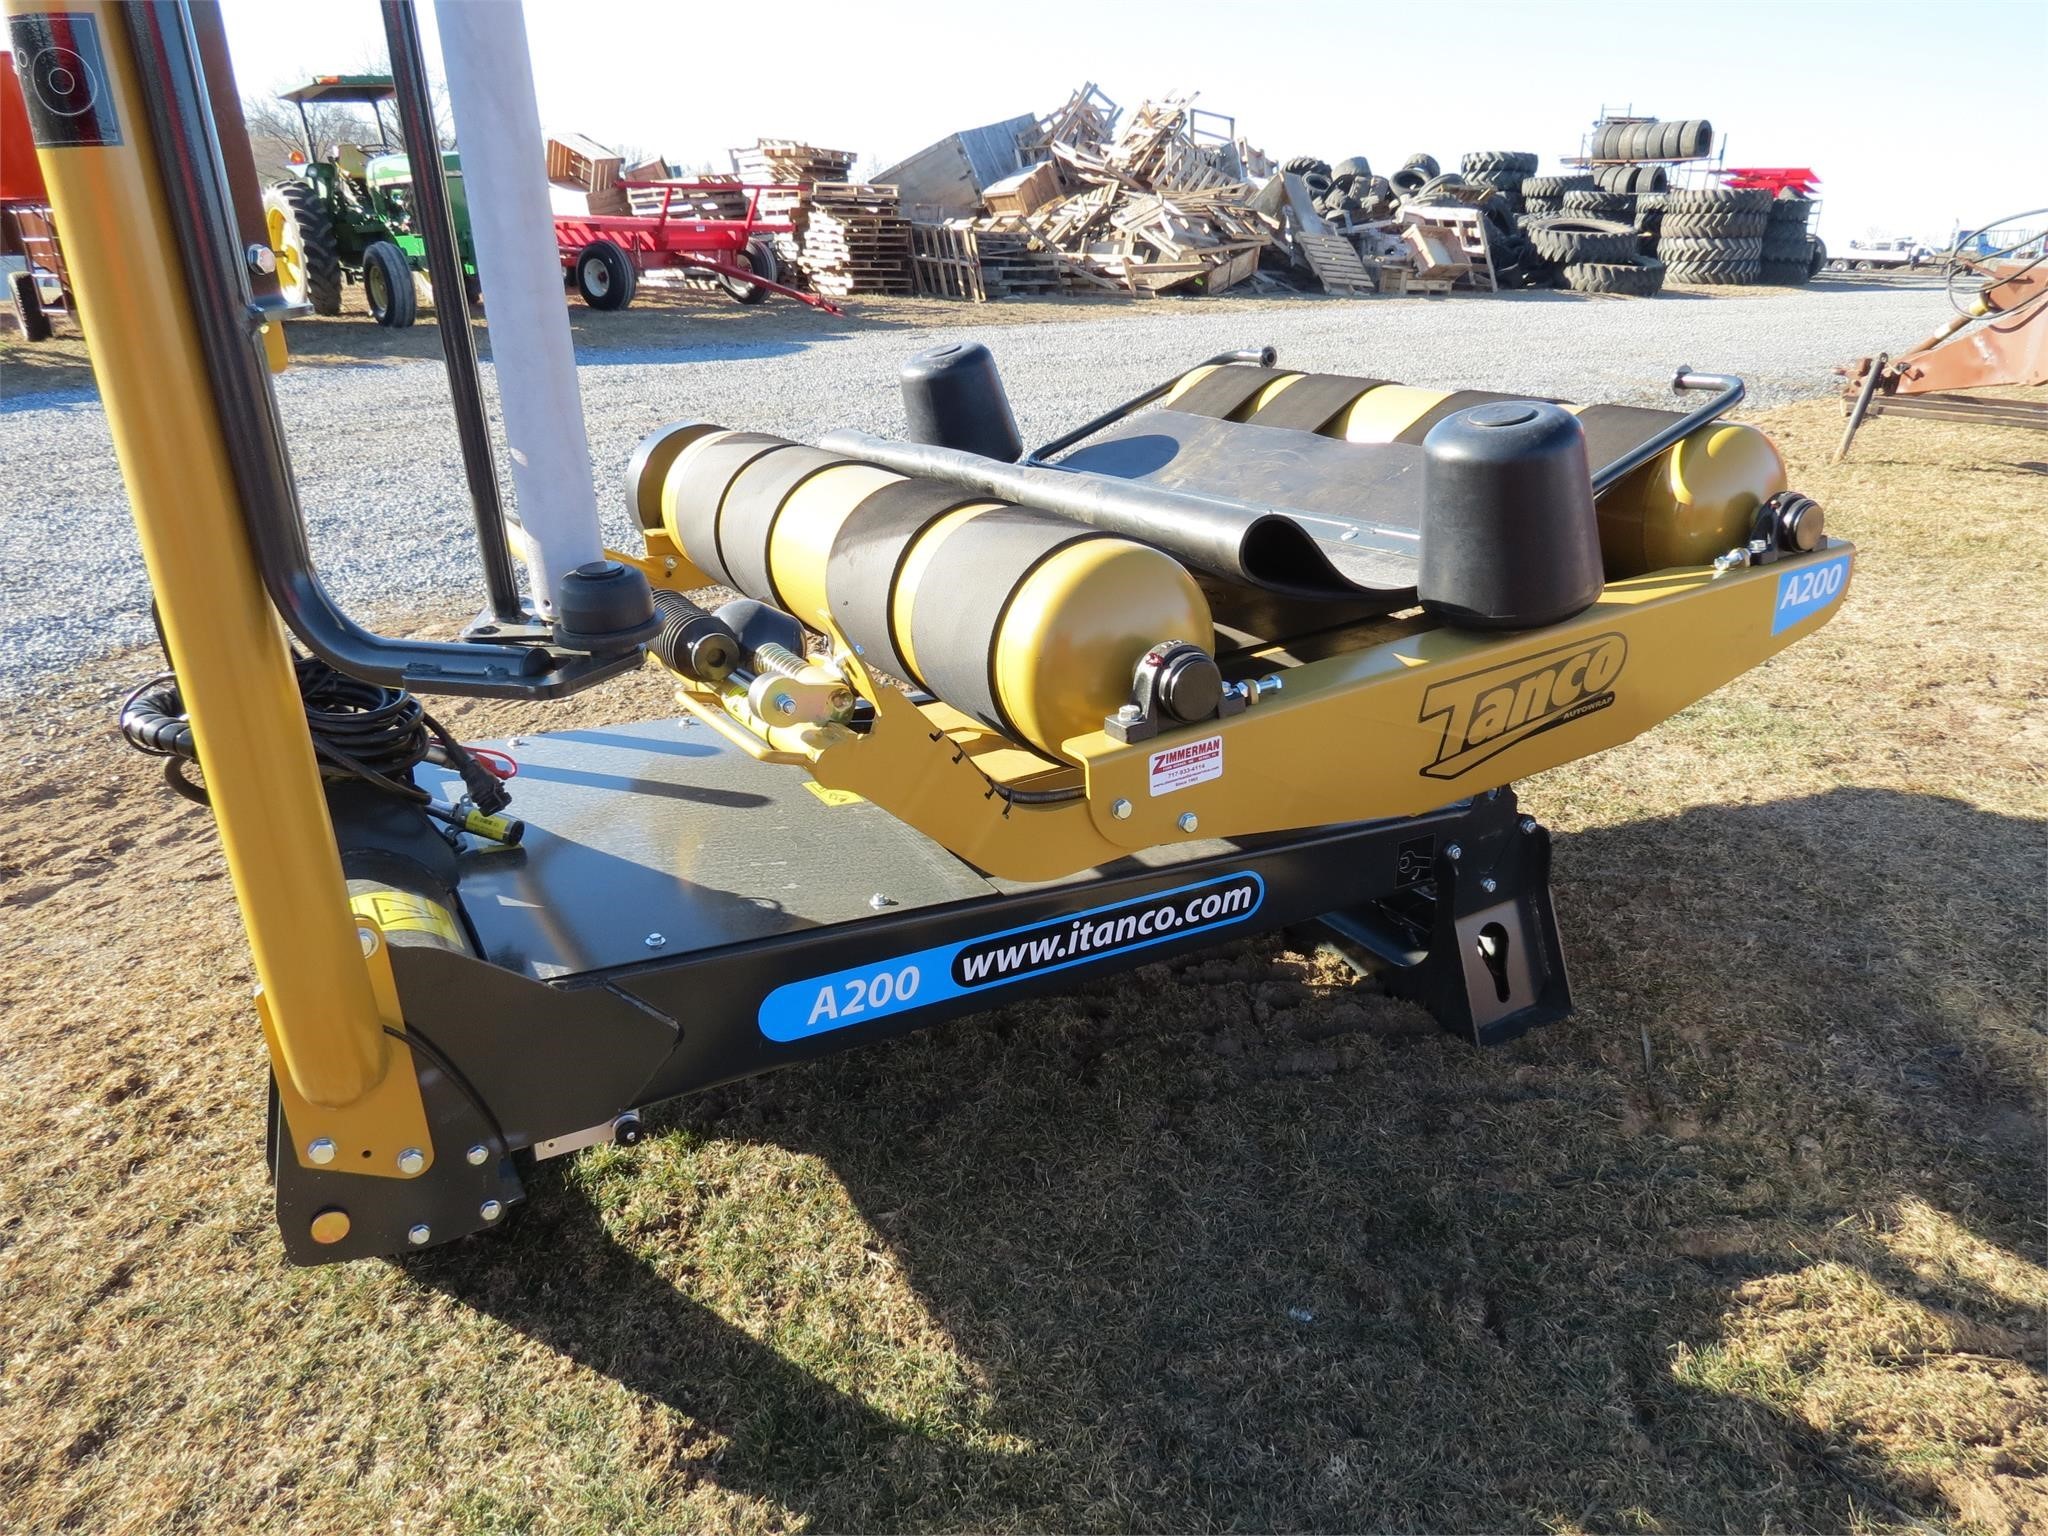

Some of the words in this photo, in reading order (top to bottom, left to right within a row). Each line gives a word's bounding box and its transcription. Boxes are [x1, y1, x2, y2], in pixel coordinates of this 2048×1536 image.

[1779, 564, 1842, 610] A200
[1420, 633, 1627, 765] Tanco
[1562, 696, 1613, 720] AUTOWRAP
[1152, 739, 1220, 775] ZIMMERMAN
[807, 965, 920, 1026] A200
[962, 882, 1252, 983] www.itanco.com
